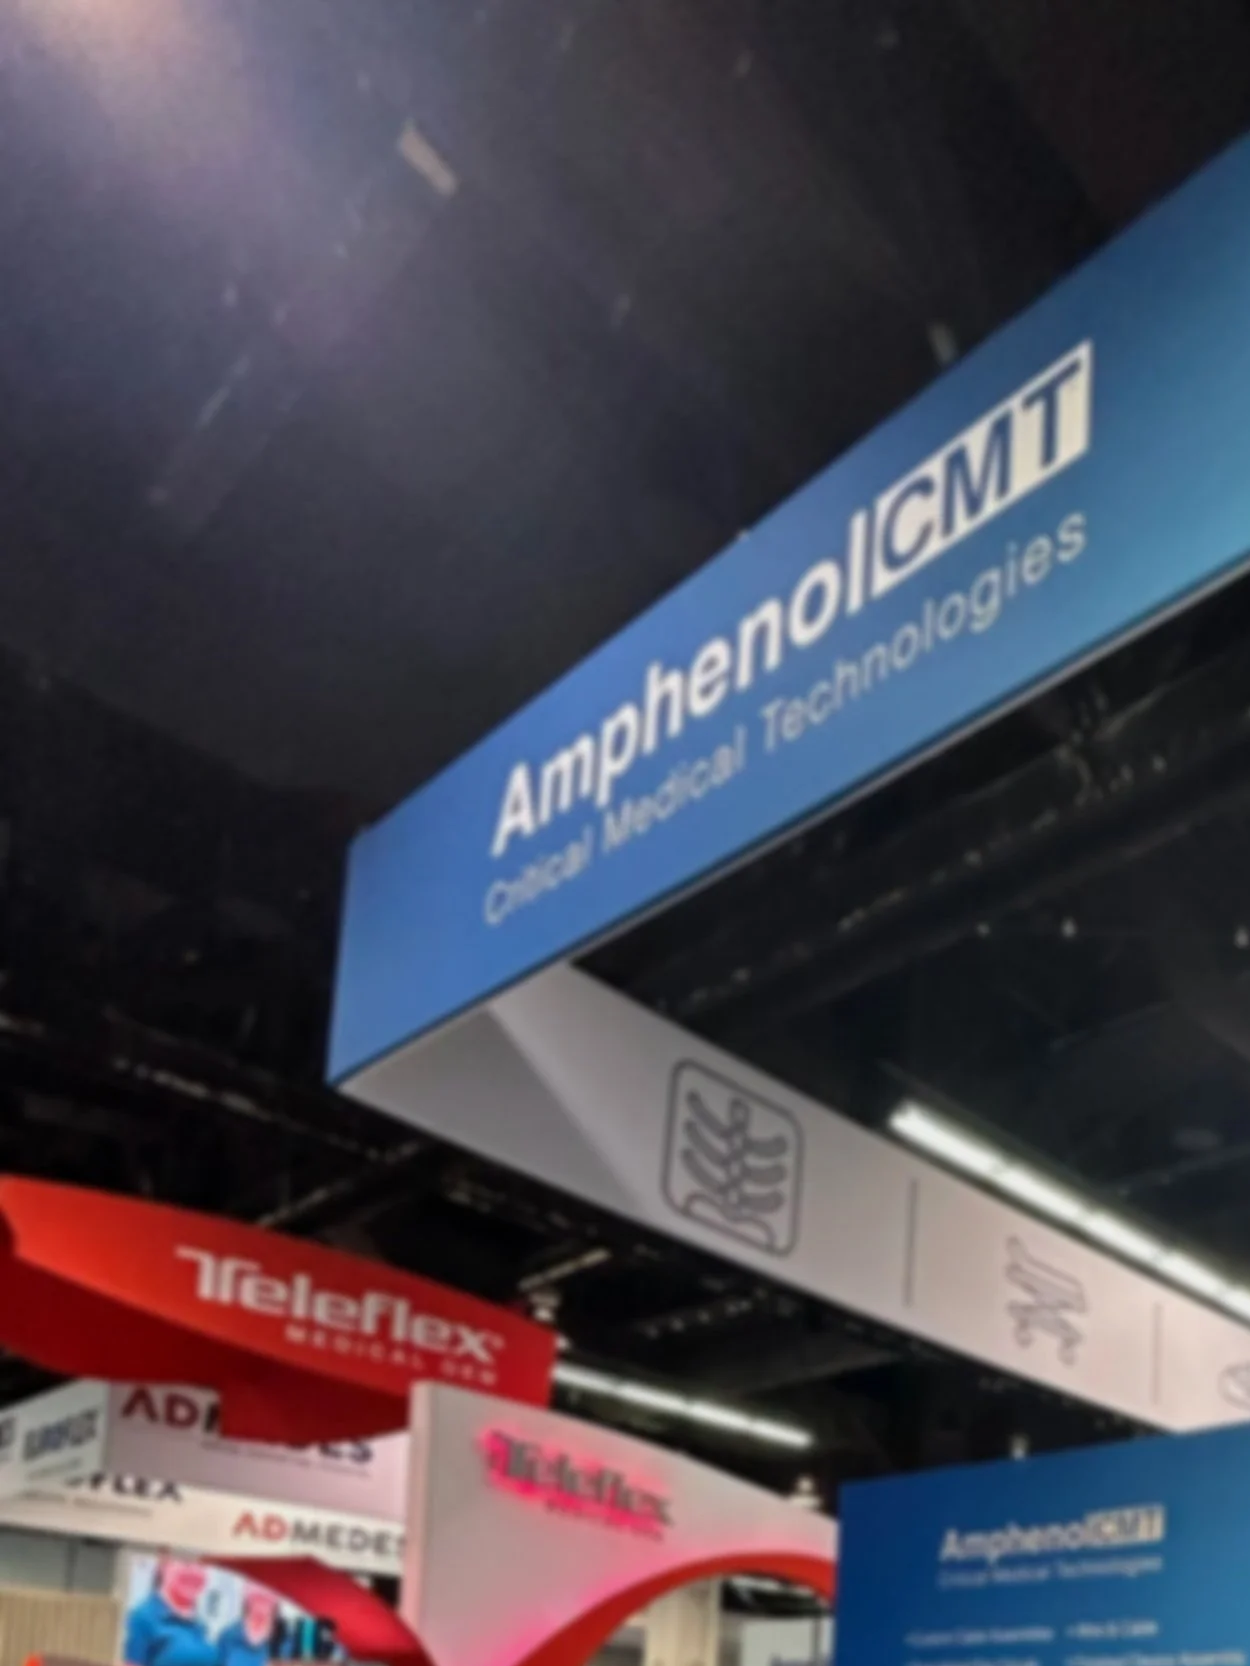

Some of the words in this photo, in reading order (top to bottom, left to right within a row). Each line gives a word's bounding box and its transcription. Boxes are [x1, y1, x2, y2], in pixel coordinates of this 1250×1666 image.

[484, 817, 592, 925] Critical
[602, 725, 747, 856] Medical
[760, 511, 1086, 752] Technologies
[175, 1245, 498, 1363] Teleflex
